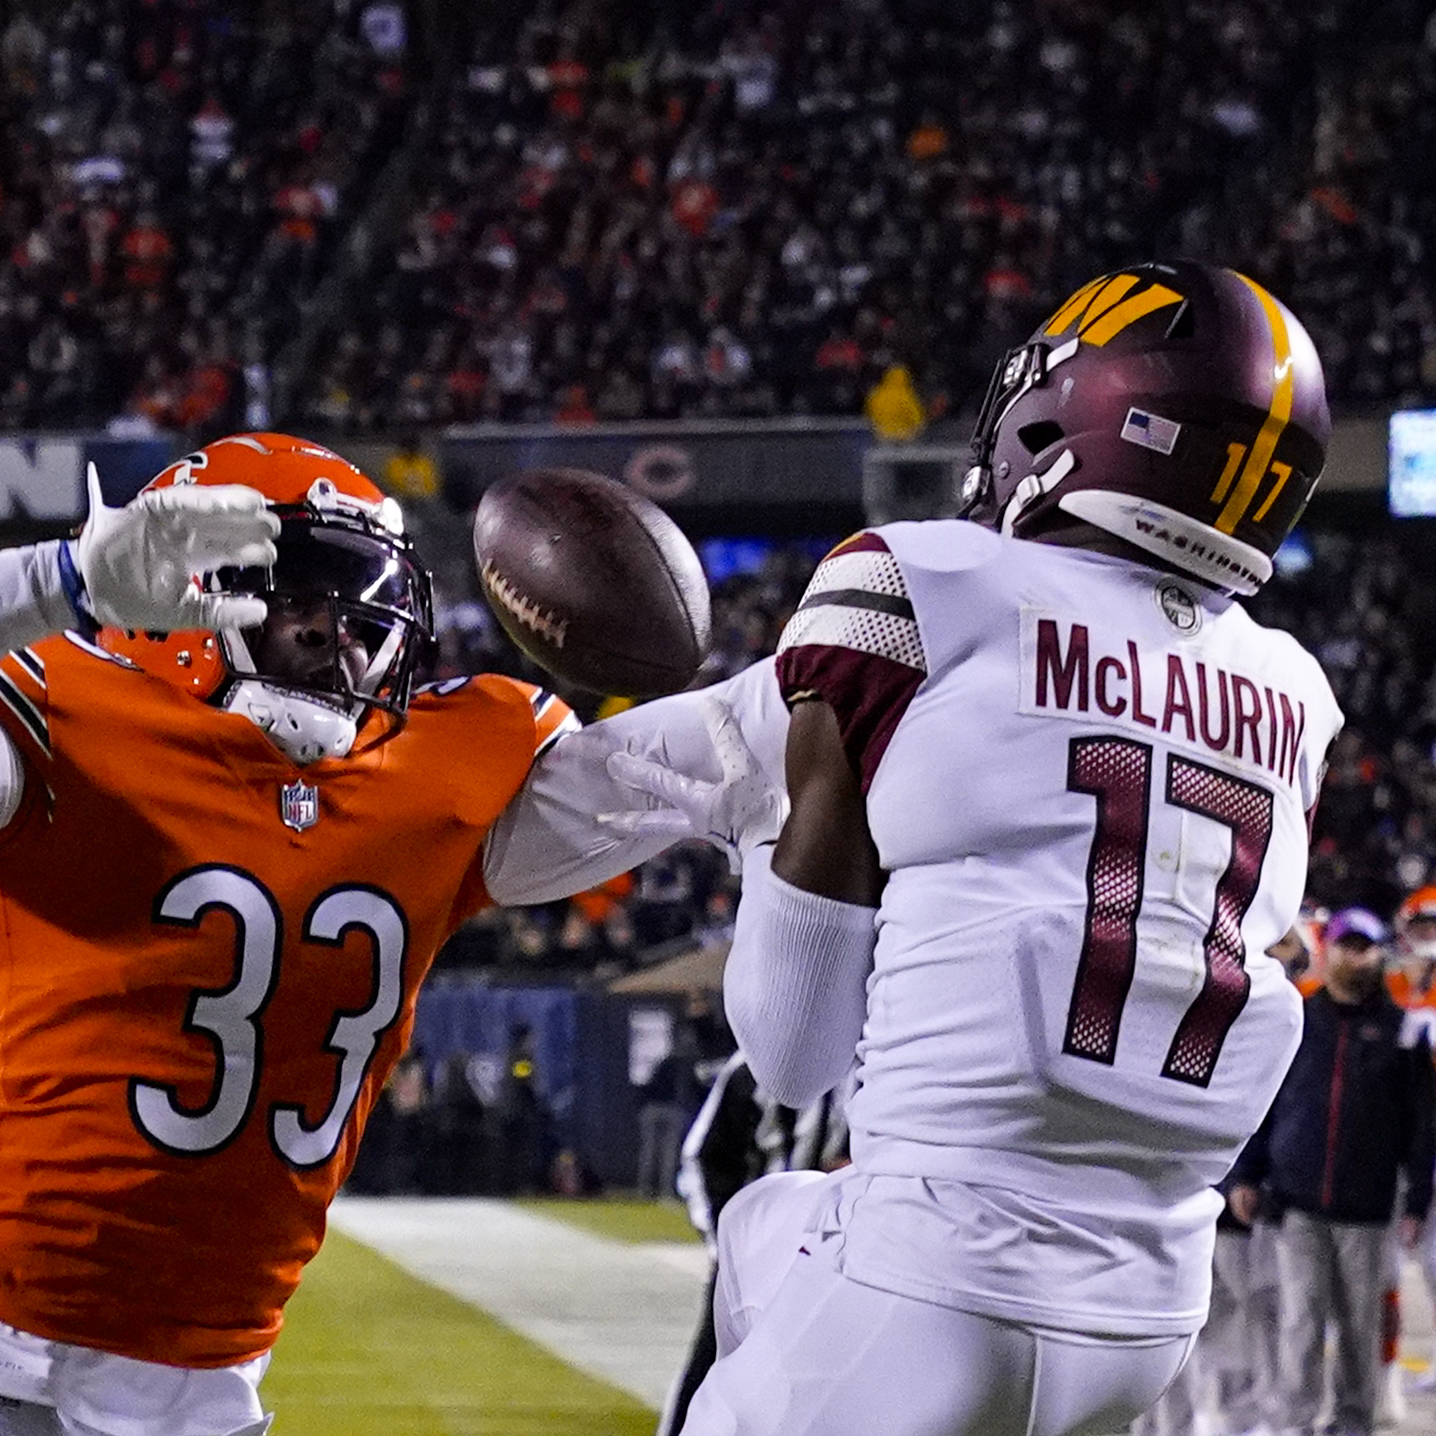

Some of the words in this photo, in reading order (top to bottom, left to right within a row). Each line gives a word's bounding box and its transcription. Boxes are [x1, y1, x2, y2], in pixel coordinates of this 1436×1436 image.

[1209, 442, 1293, 523] 17
[1034, 618, 1306, 790] McLAURIN
[285, 801, 314, 822] NFL
[1062, 734, 1275, 1089] 17
[127, 862, 410, 1171] 33
